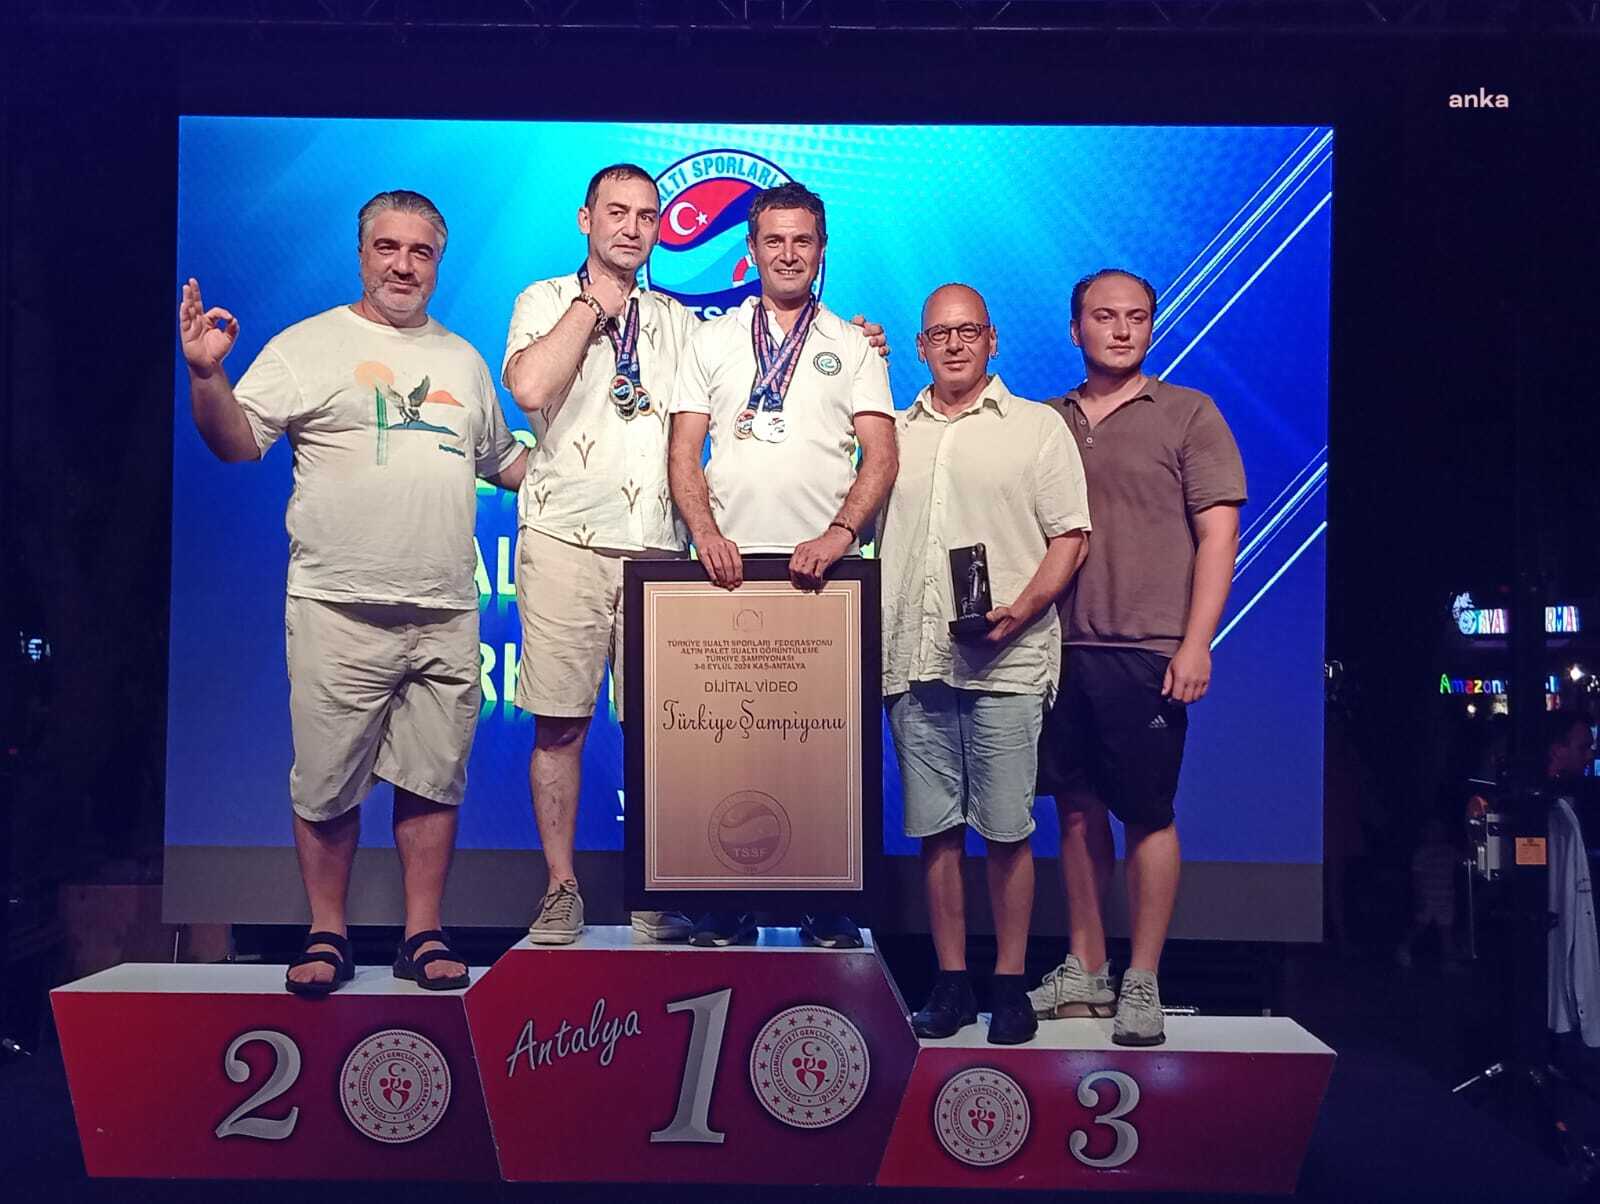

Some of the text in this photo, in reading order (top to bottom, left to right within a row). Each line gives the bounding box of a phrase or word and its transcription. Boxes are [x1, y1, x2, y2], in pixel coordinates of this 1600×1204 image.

[692, 156, 779, 188] SPORLARI
[662, 699, 847, 743] Türkiye Şampiyonu
[704, 679, 798, 693] DİJİTAL VİDEO
[506, 998, 642, 1078] Antalya
[650, 988, 732, 1143] 1
[215, 1030, 301, 1140] 2
[1069, 1070, 1140, 1168] 3
